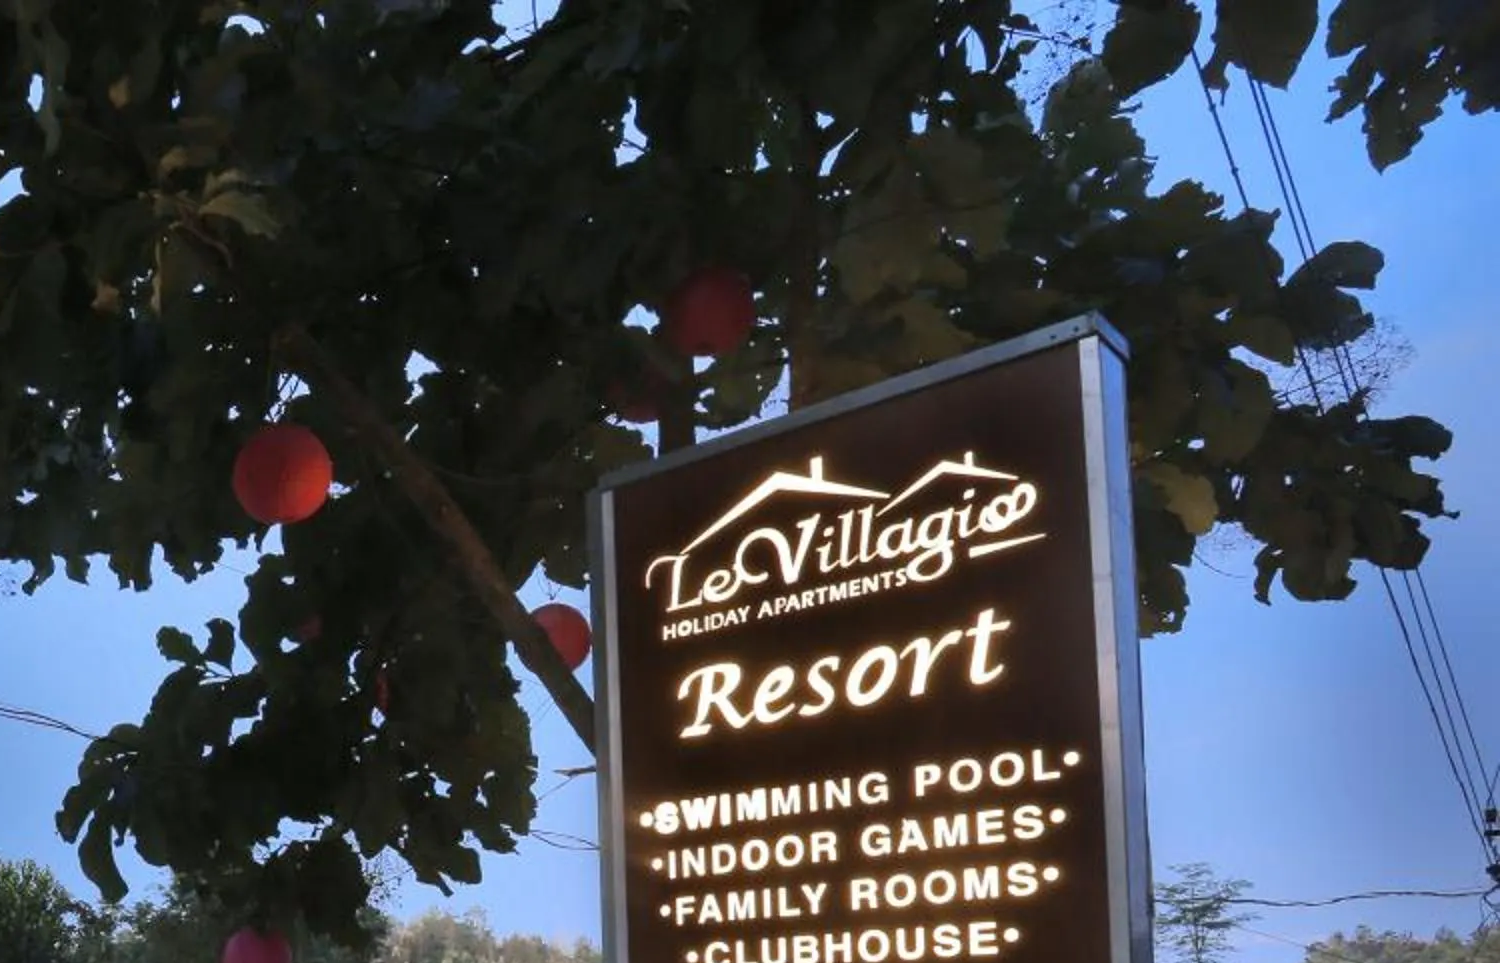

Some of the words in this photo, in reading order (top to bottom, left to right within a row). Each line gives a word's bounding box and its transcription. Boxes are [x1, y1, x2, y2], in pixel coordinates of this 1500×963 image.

[663, 605, 750, 640] HOLIDAY
[758, 566, 908, 619] APARTMENTS
[678, 608, 1010, 738] Resort
[654, 772, 889, 834] SWIMMING
[915, 749, 1061, 797] POOL
[668, 831, 838, 880] INDOOR
[861, 805, 1045, 857] GAMES
[676, 883, 828, 926] FAMILY
[851, 862, 1039, 911] ROOMS
